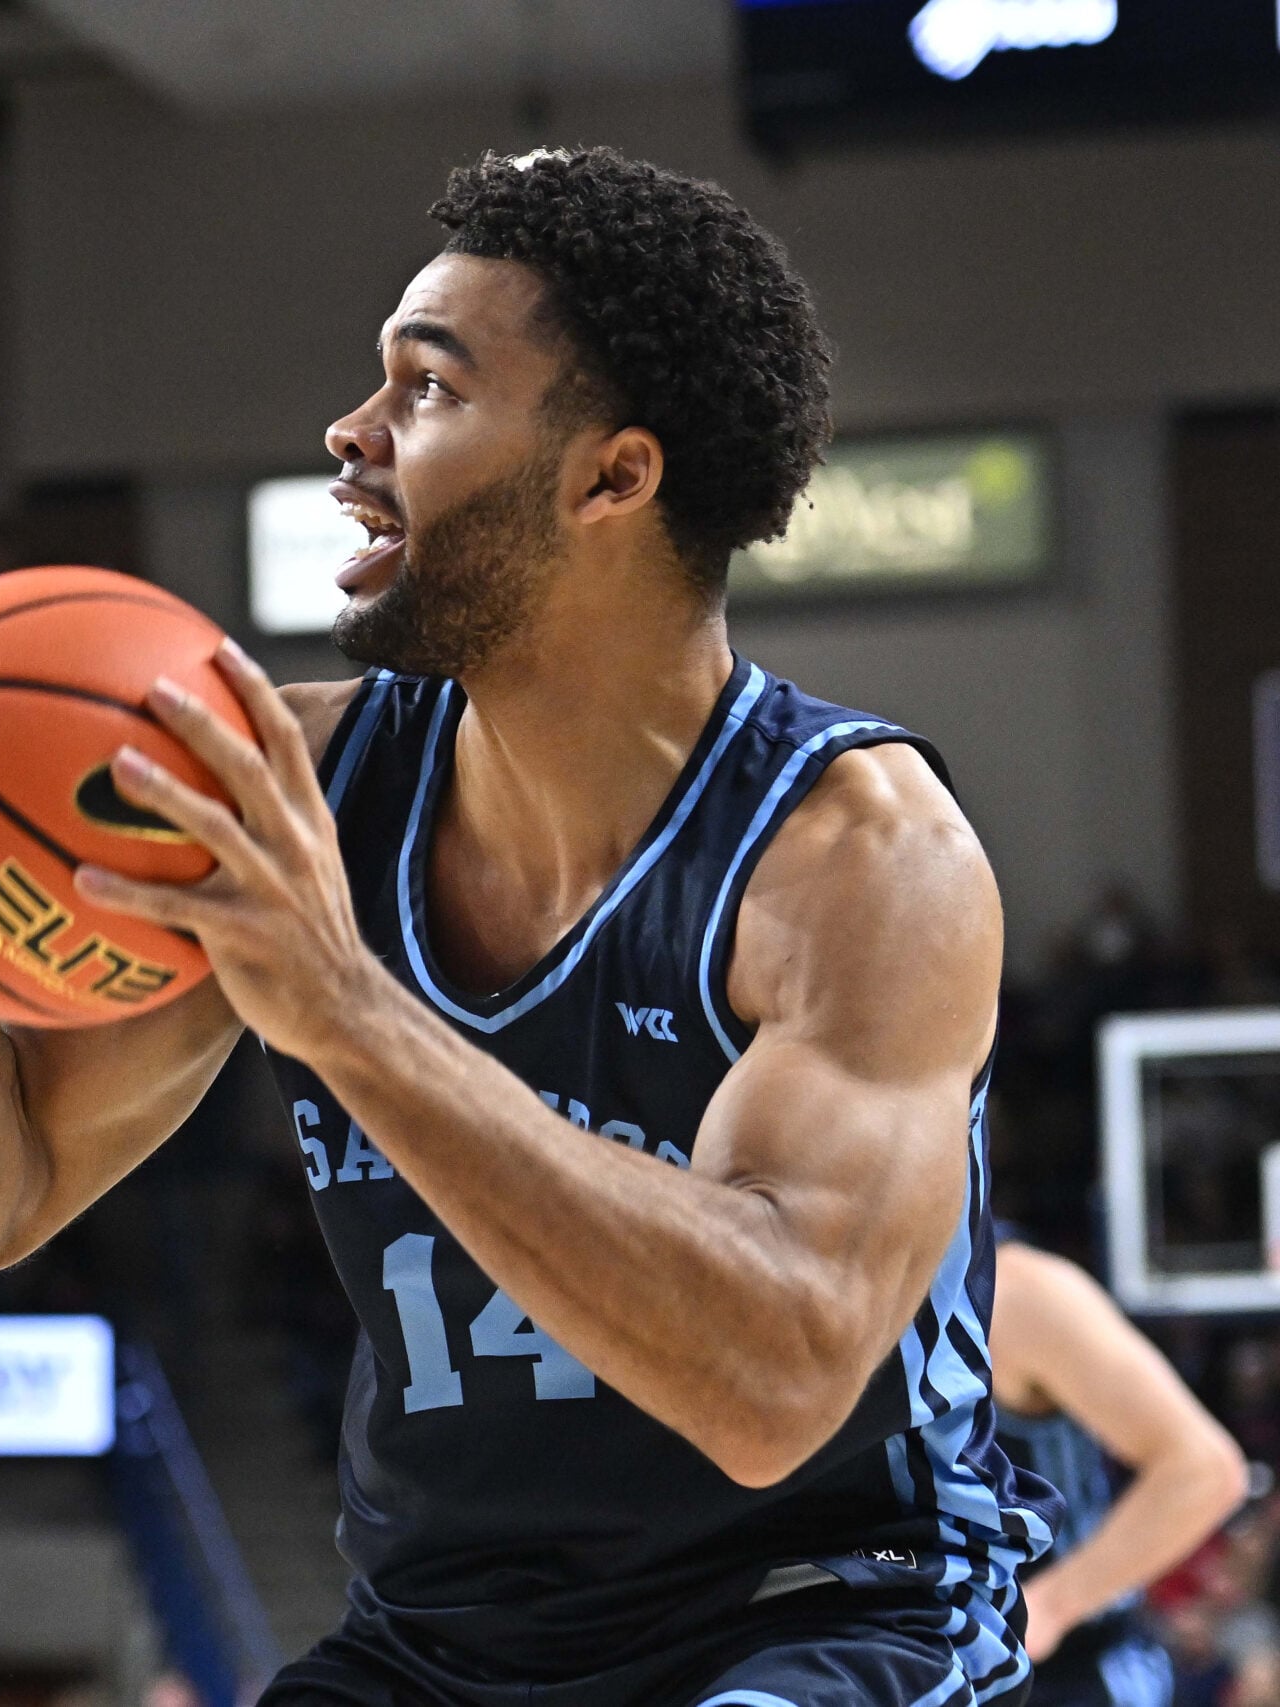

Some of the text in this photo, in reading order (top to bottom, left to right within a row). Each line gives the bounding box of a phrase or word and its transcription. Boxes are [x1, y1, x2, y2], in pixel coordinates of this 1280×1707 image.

[614, 1002, 680, 1043] WCC
[293, 1099, 402, 1191] SA
[872, 1549, 905, 1562] XL
